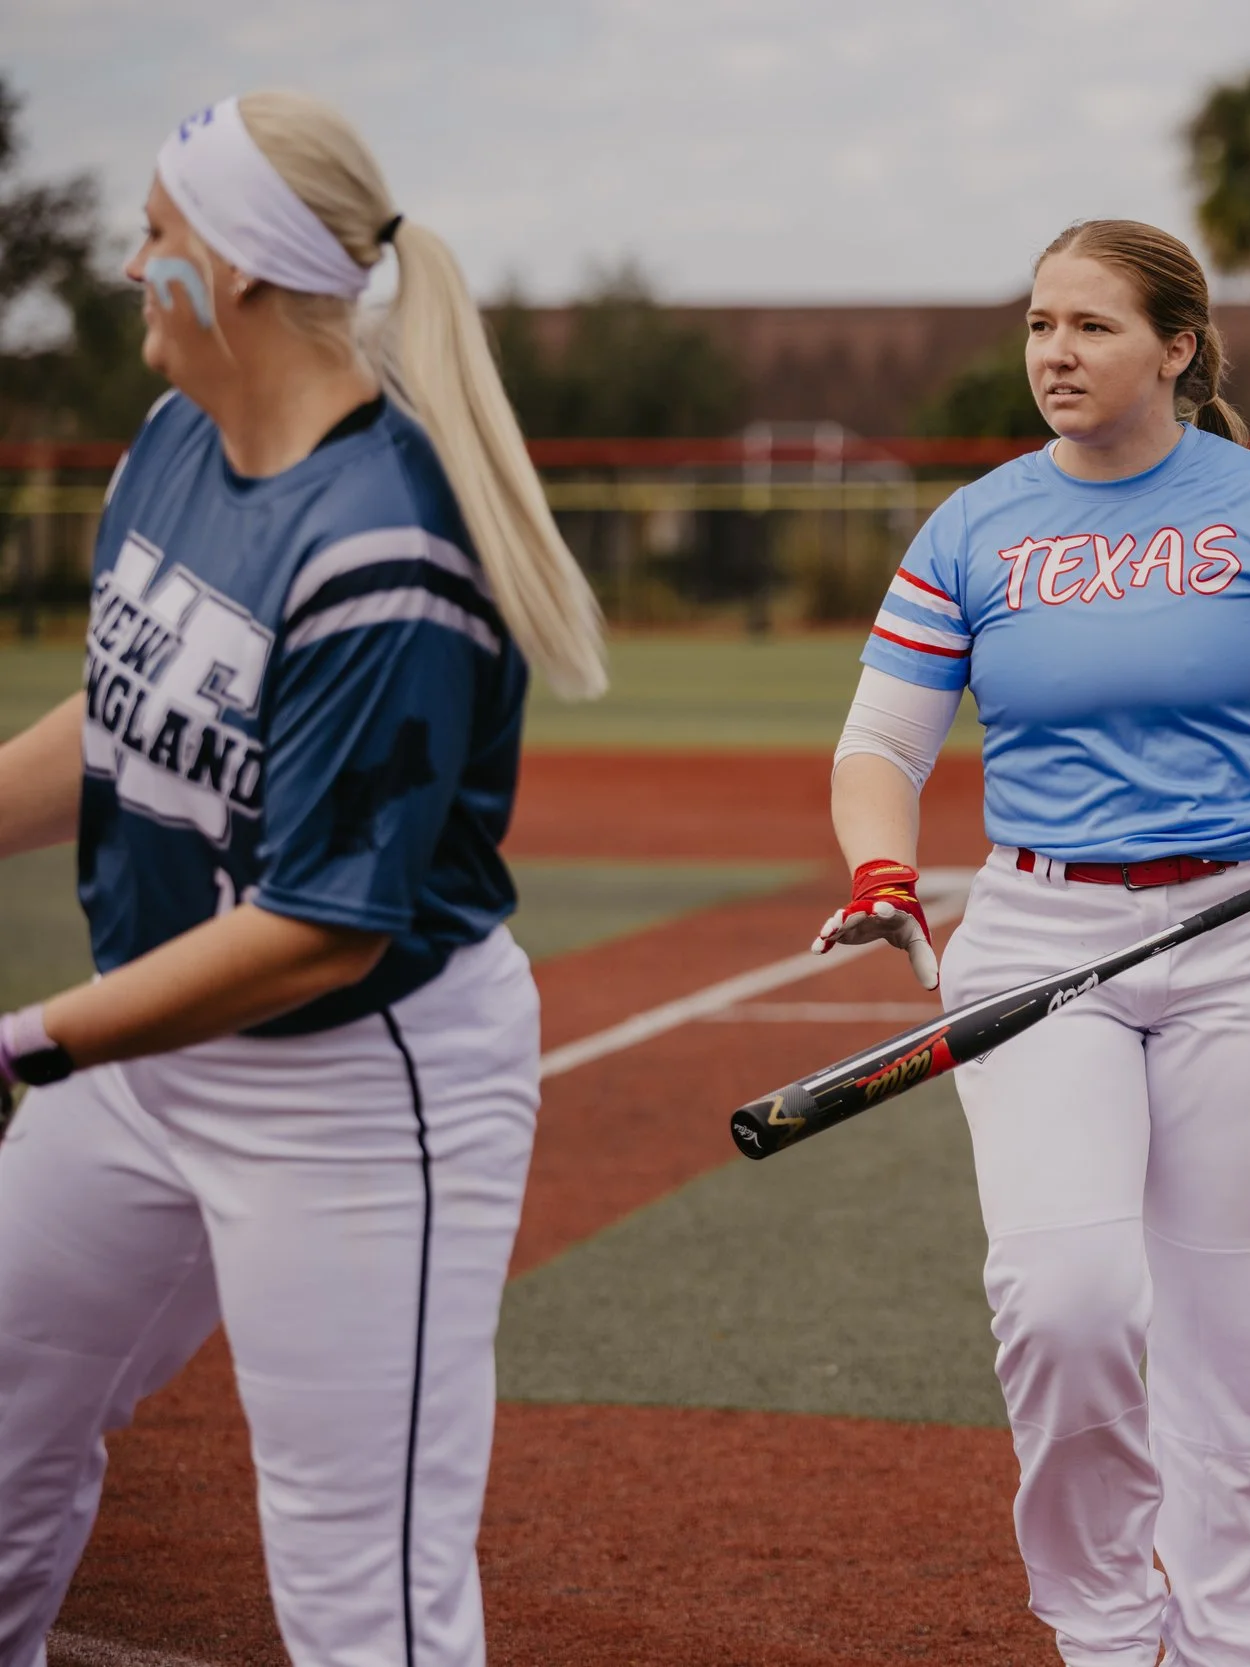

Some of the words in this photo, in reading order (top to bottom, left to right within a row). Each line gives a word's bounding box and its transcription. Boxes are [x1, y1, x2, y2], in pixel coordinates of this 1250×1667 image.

[998, 524, 1242, 611] TEXAS
[84, 658, 263, 812] NGLAND
[732, 1122, 763, 1149] Victus
